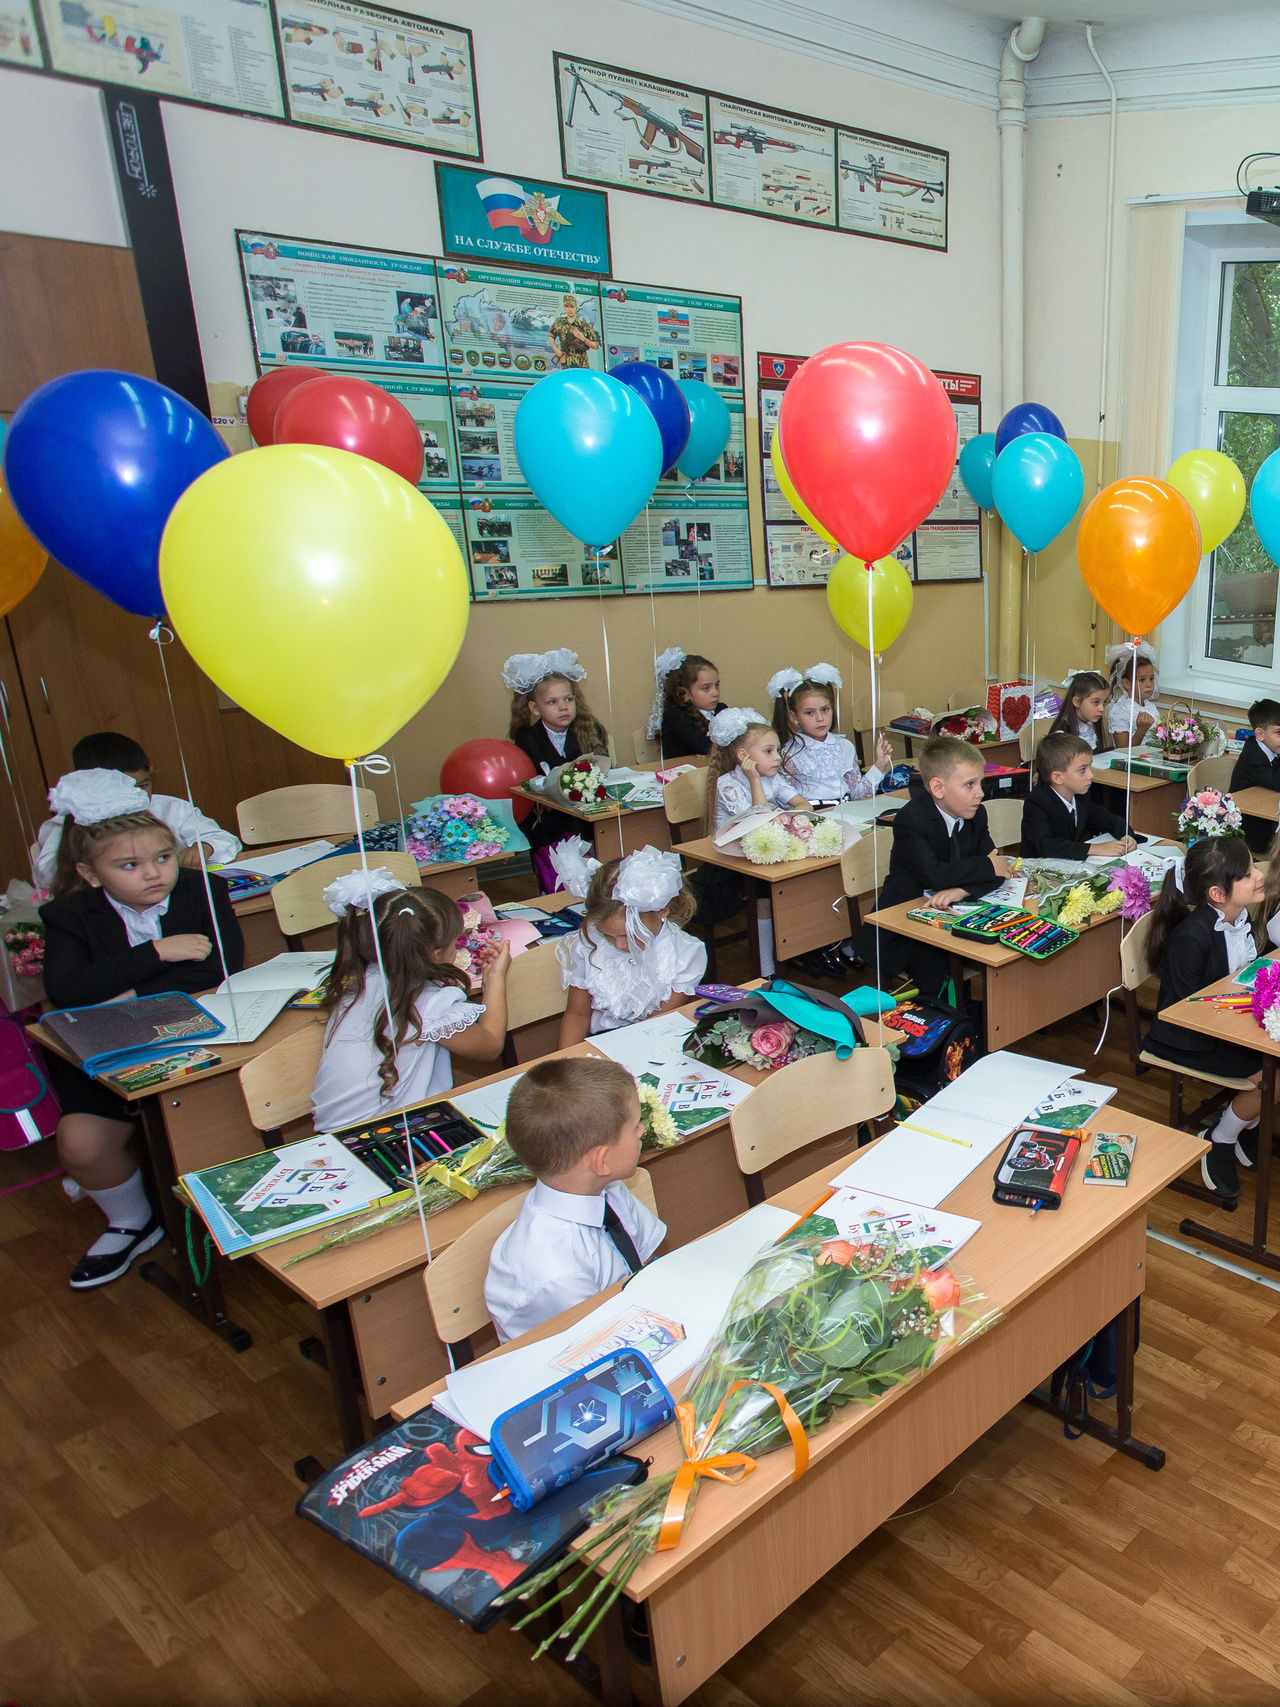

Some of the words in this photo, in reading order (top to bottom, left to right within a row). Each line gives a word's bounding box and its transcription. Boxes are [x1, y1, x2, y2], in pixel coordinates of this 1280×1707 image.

[353, 7, 399, 24] РАЗБОРКА
[401, 18, 445, 36] АВТОМАТА
[578, 65, 607, 78] РУЧНОЙ
[639, 80, 690, 99] КАЛАШНИКОВА
[719, 101, 761, 117] СНАЙПЕРСКАЯ
[762, 112, 792, 125] ВИНТОВКА
[793, 120, 826, 133] ДРАГУНОВА
[455, 234, 475, 247] НА
[476, 238, 532, 255] СЛУЖБЕ
[533, 247, 602, 265] ОТЕЧЕСТВУ
[886, 1015, 929, 1038] STARS
[902, 1012, 926, 1026] BRAWL
[251, 1168, 295, 1202] Букварь
[319, 1172, 338, 1181] А
[895, 1220, 913, 1229] А
[901, 1231, 915, 1239] Б
[332, 1446, 413, 1506] SPIDER-MAN
